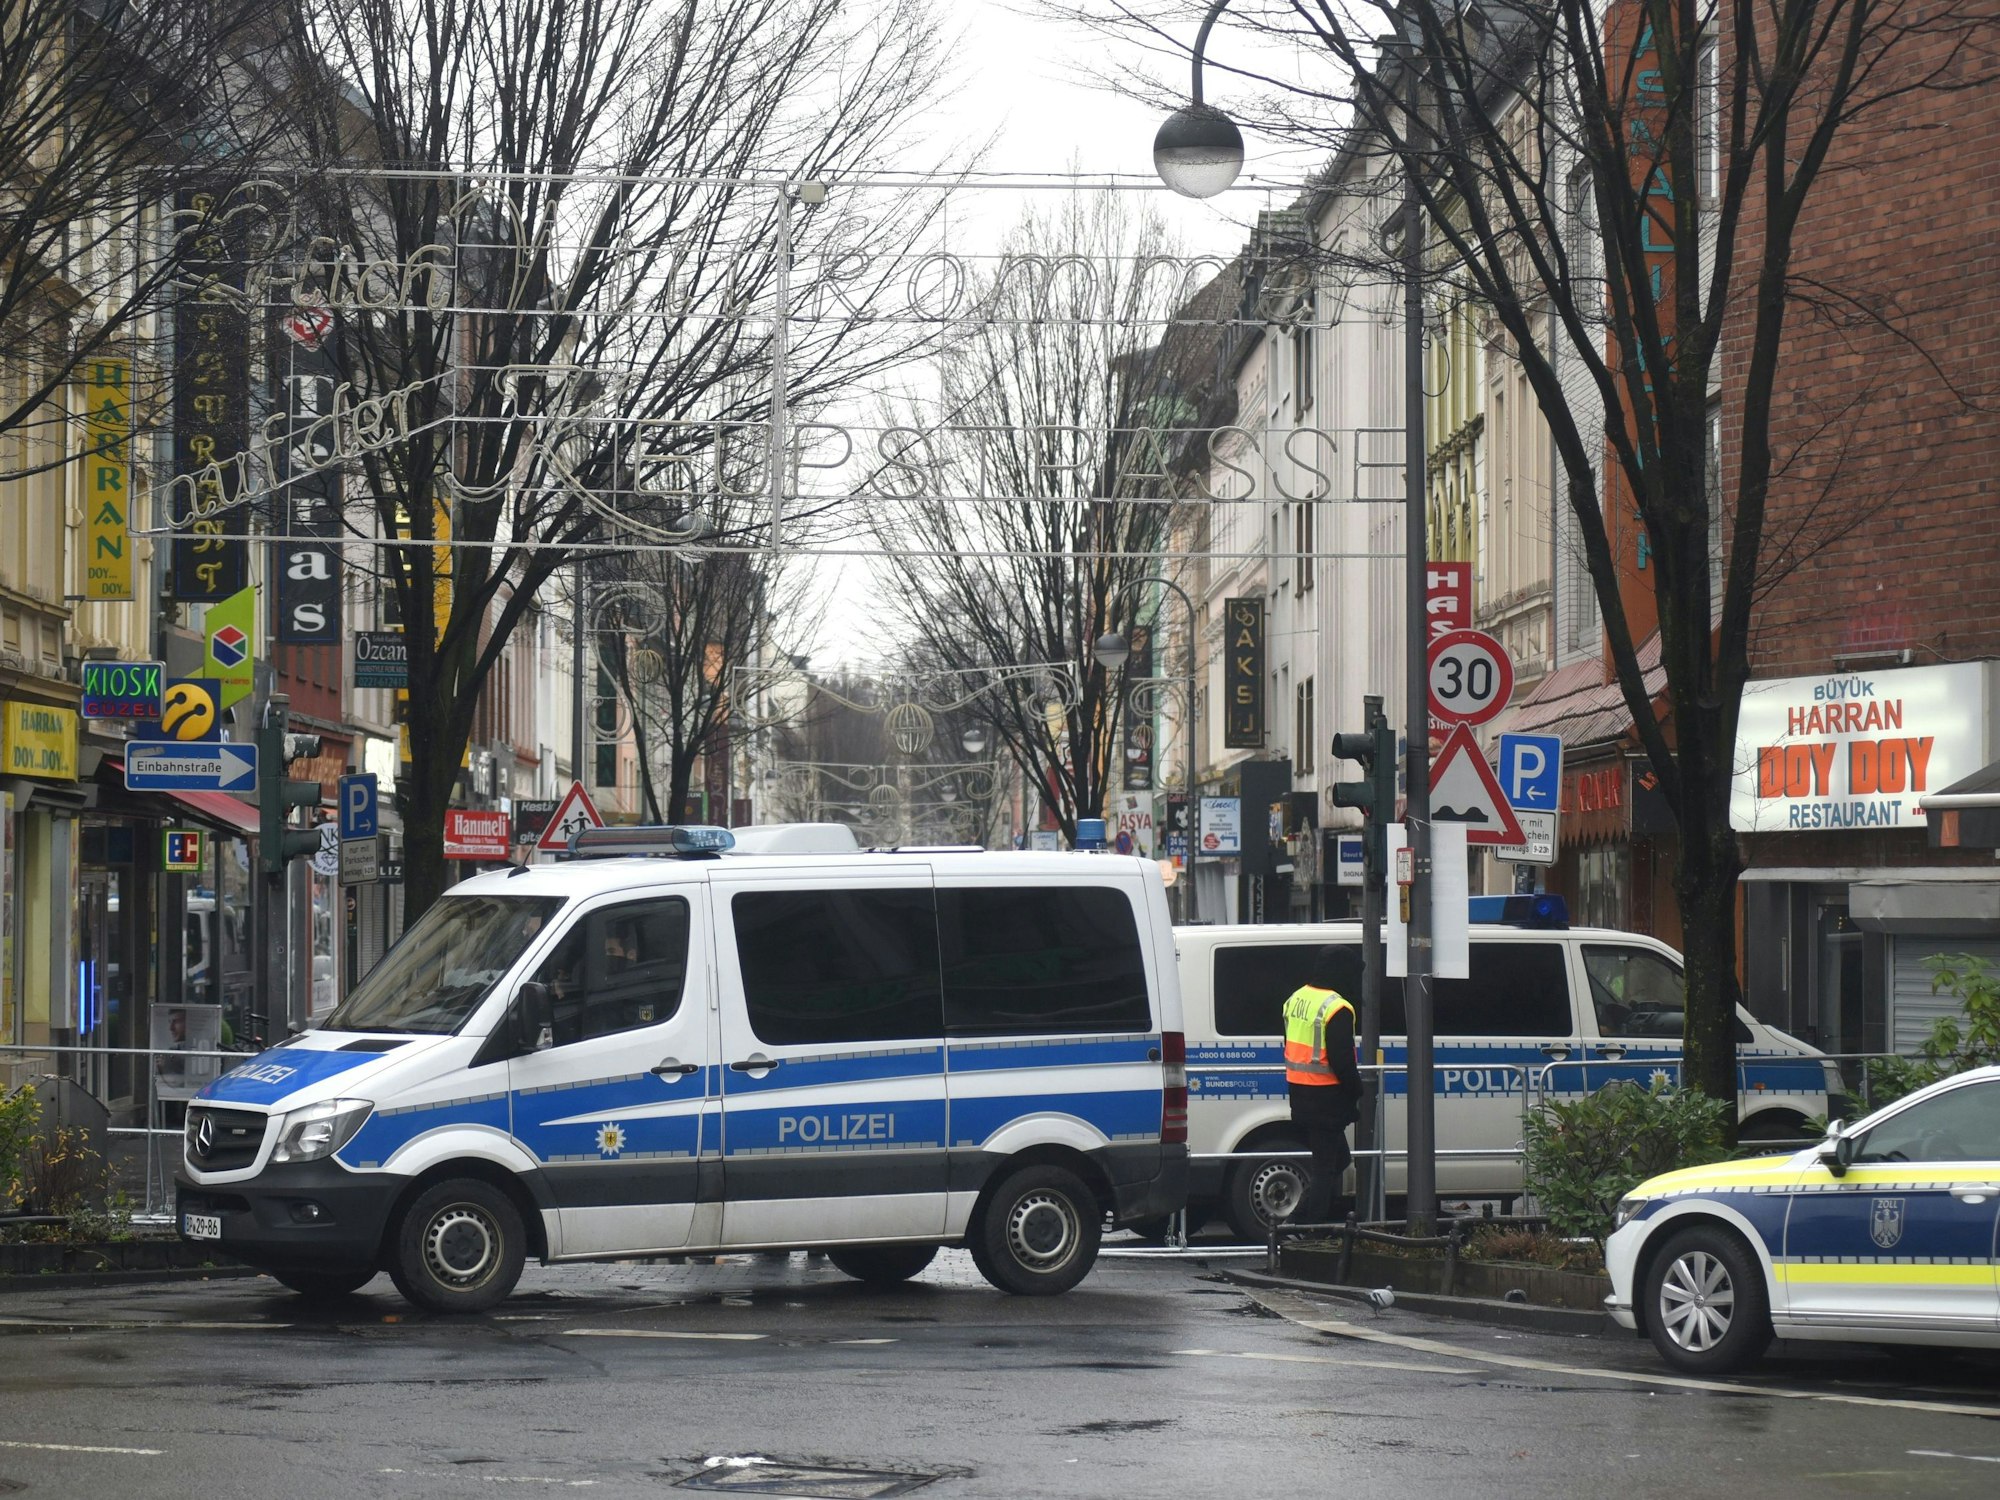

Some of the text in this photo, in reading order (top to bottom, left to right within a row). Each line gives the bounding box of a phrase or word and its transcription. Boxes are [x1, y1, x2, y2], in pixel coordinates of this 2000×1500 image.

[93, 362, 125, 560] HARRAN
[161, 411, 285, 530] auf
[356, 632, 407, 661] Özcan
[85, 665, 159, 697] KIOSK
[1437, 657, 1492, 700] 30
[1814, 676, 1874, 700] BÜYÜK
[20, 709, 63, 733] HARRAN
[85, 702, 160, 717] GÜZEL
[1788, 699, 1902, 736] HARRAN
[136, 761, 222, 773] Einbahnstraße
[1513, 744, 1546, 799] P
[1757, 736, 1935, 798] DOY DOY
[349, 784, 369, 831] P
[1789, 800, 1902, 829] RESTAURANT
[1119, 814, 1152, 830] ASYA
[1529, 816, 1543, 828] mit
[1526, 832, 1550, 841] chein
[1532, 846, 1550, 854] 9-23h
[1290, 997, 1311, 1022] ZOLL
[1199, 1051, 1219, 1059] 0800
[1220, 1051, 1225, 1059] 6
[1226, 1051, 1241, 1059] 888
[1241, 1051, 1256, 1059] 000
[218, 1064, 298, 1085] POLIZEI
[1443, 1069, 1554, 1092] POLIZEI
[778, 1113, 895, 1142] POLIZEI
[1877, 1200, 1898, 1209] ZOLL
[196, 1217, 218, 1236] 29-86
